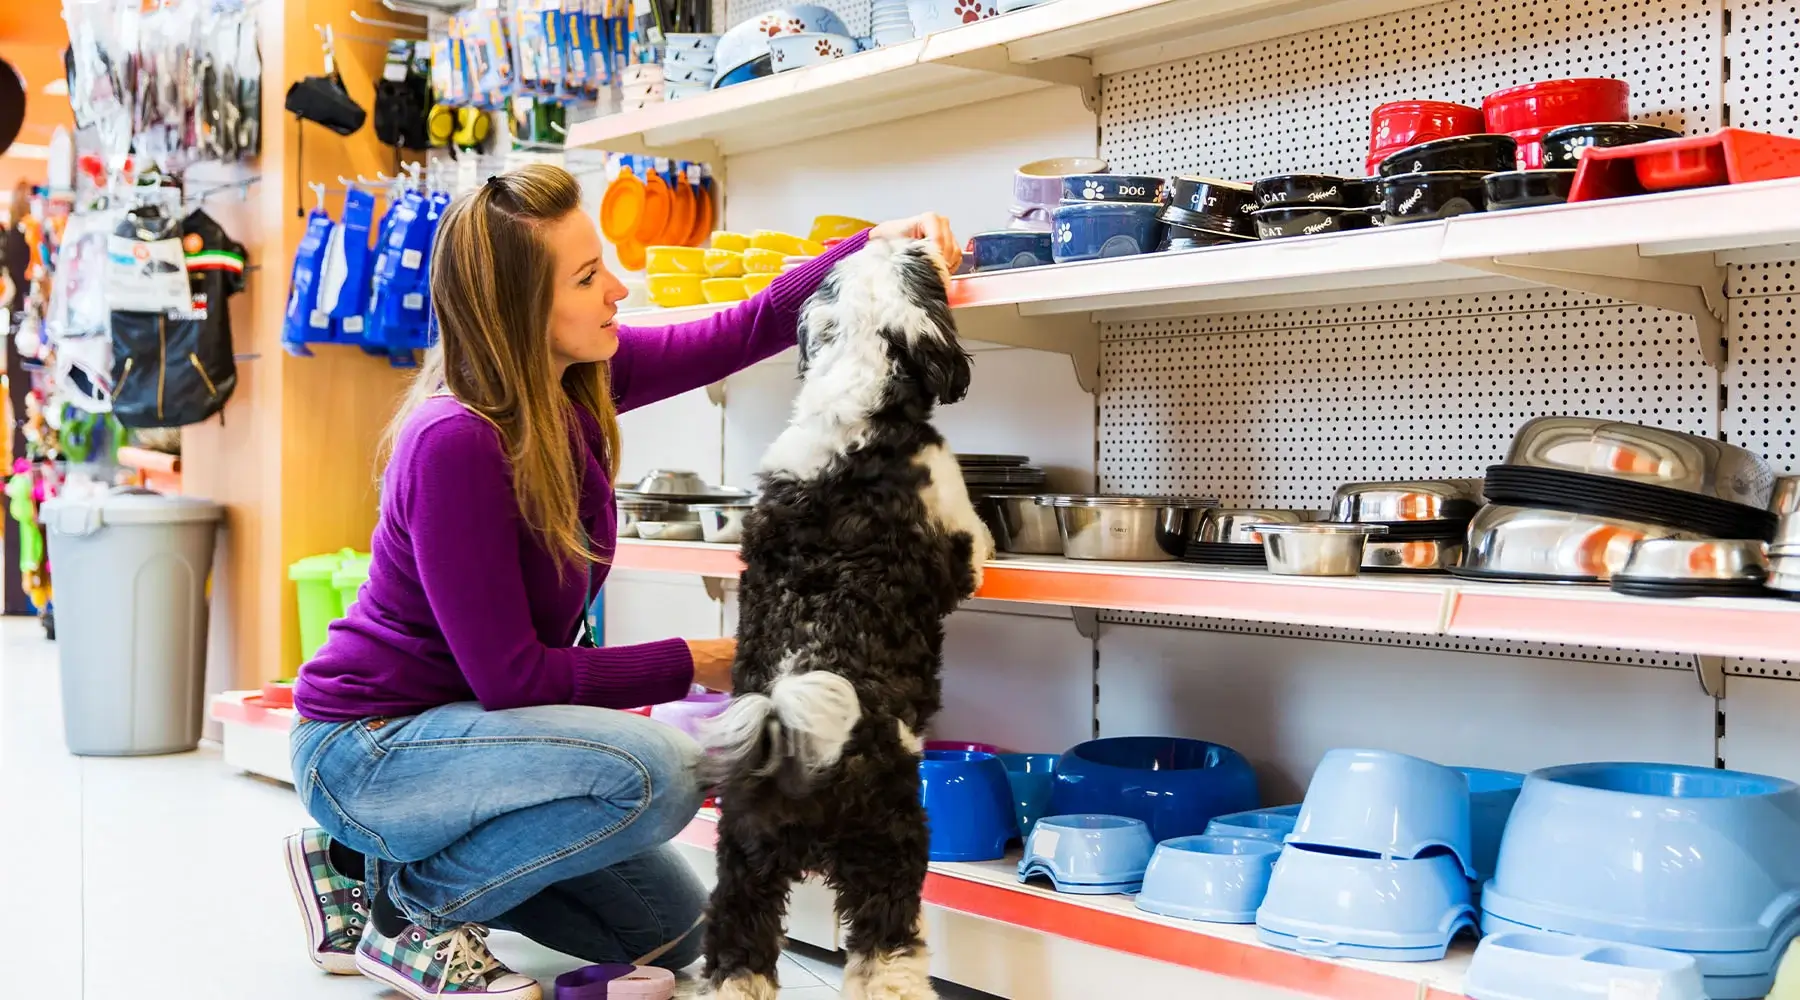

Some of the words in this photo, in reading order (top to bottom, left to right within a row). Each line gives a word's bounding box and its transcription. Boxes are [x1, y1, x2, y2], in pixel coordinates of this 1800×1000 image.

[1119, 185, 1145, 196] DOG
[1264, 192, 1287, 203] CAT
[1261, 227, 1283, 237] CAT
